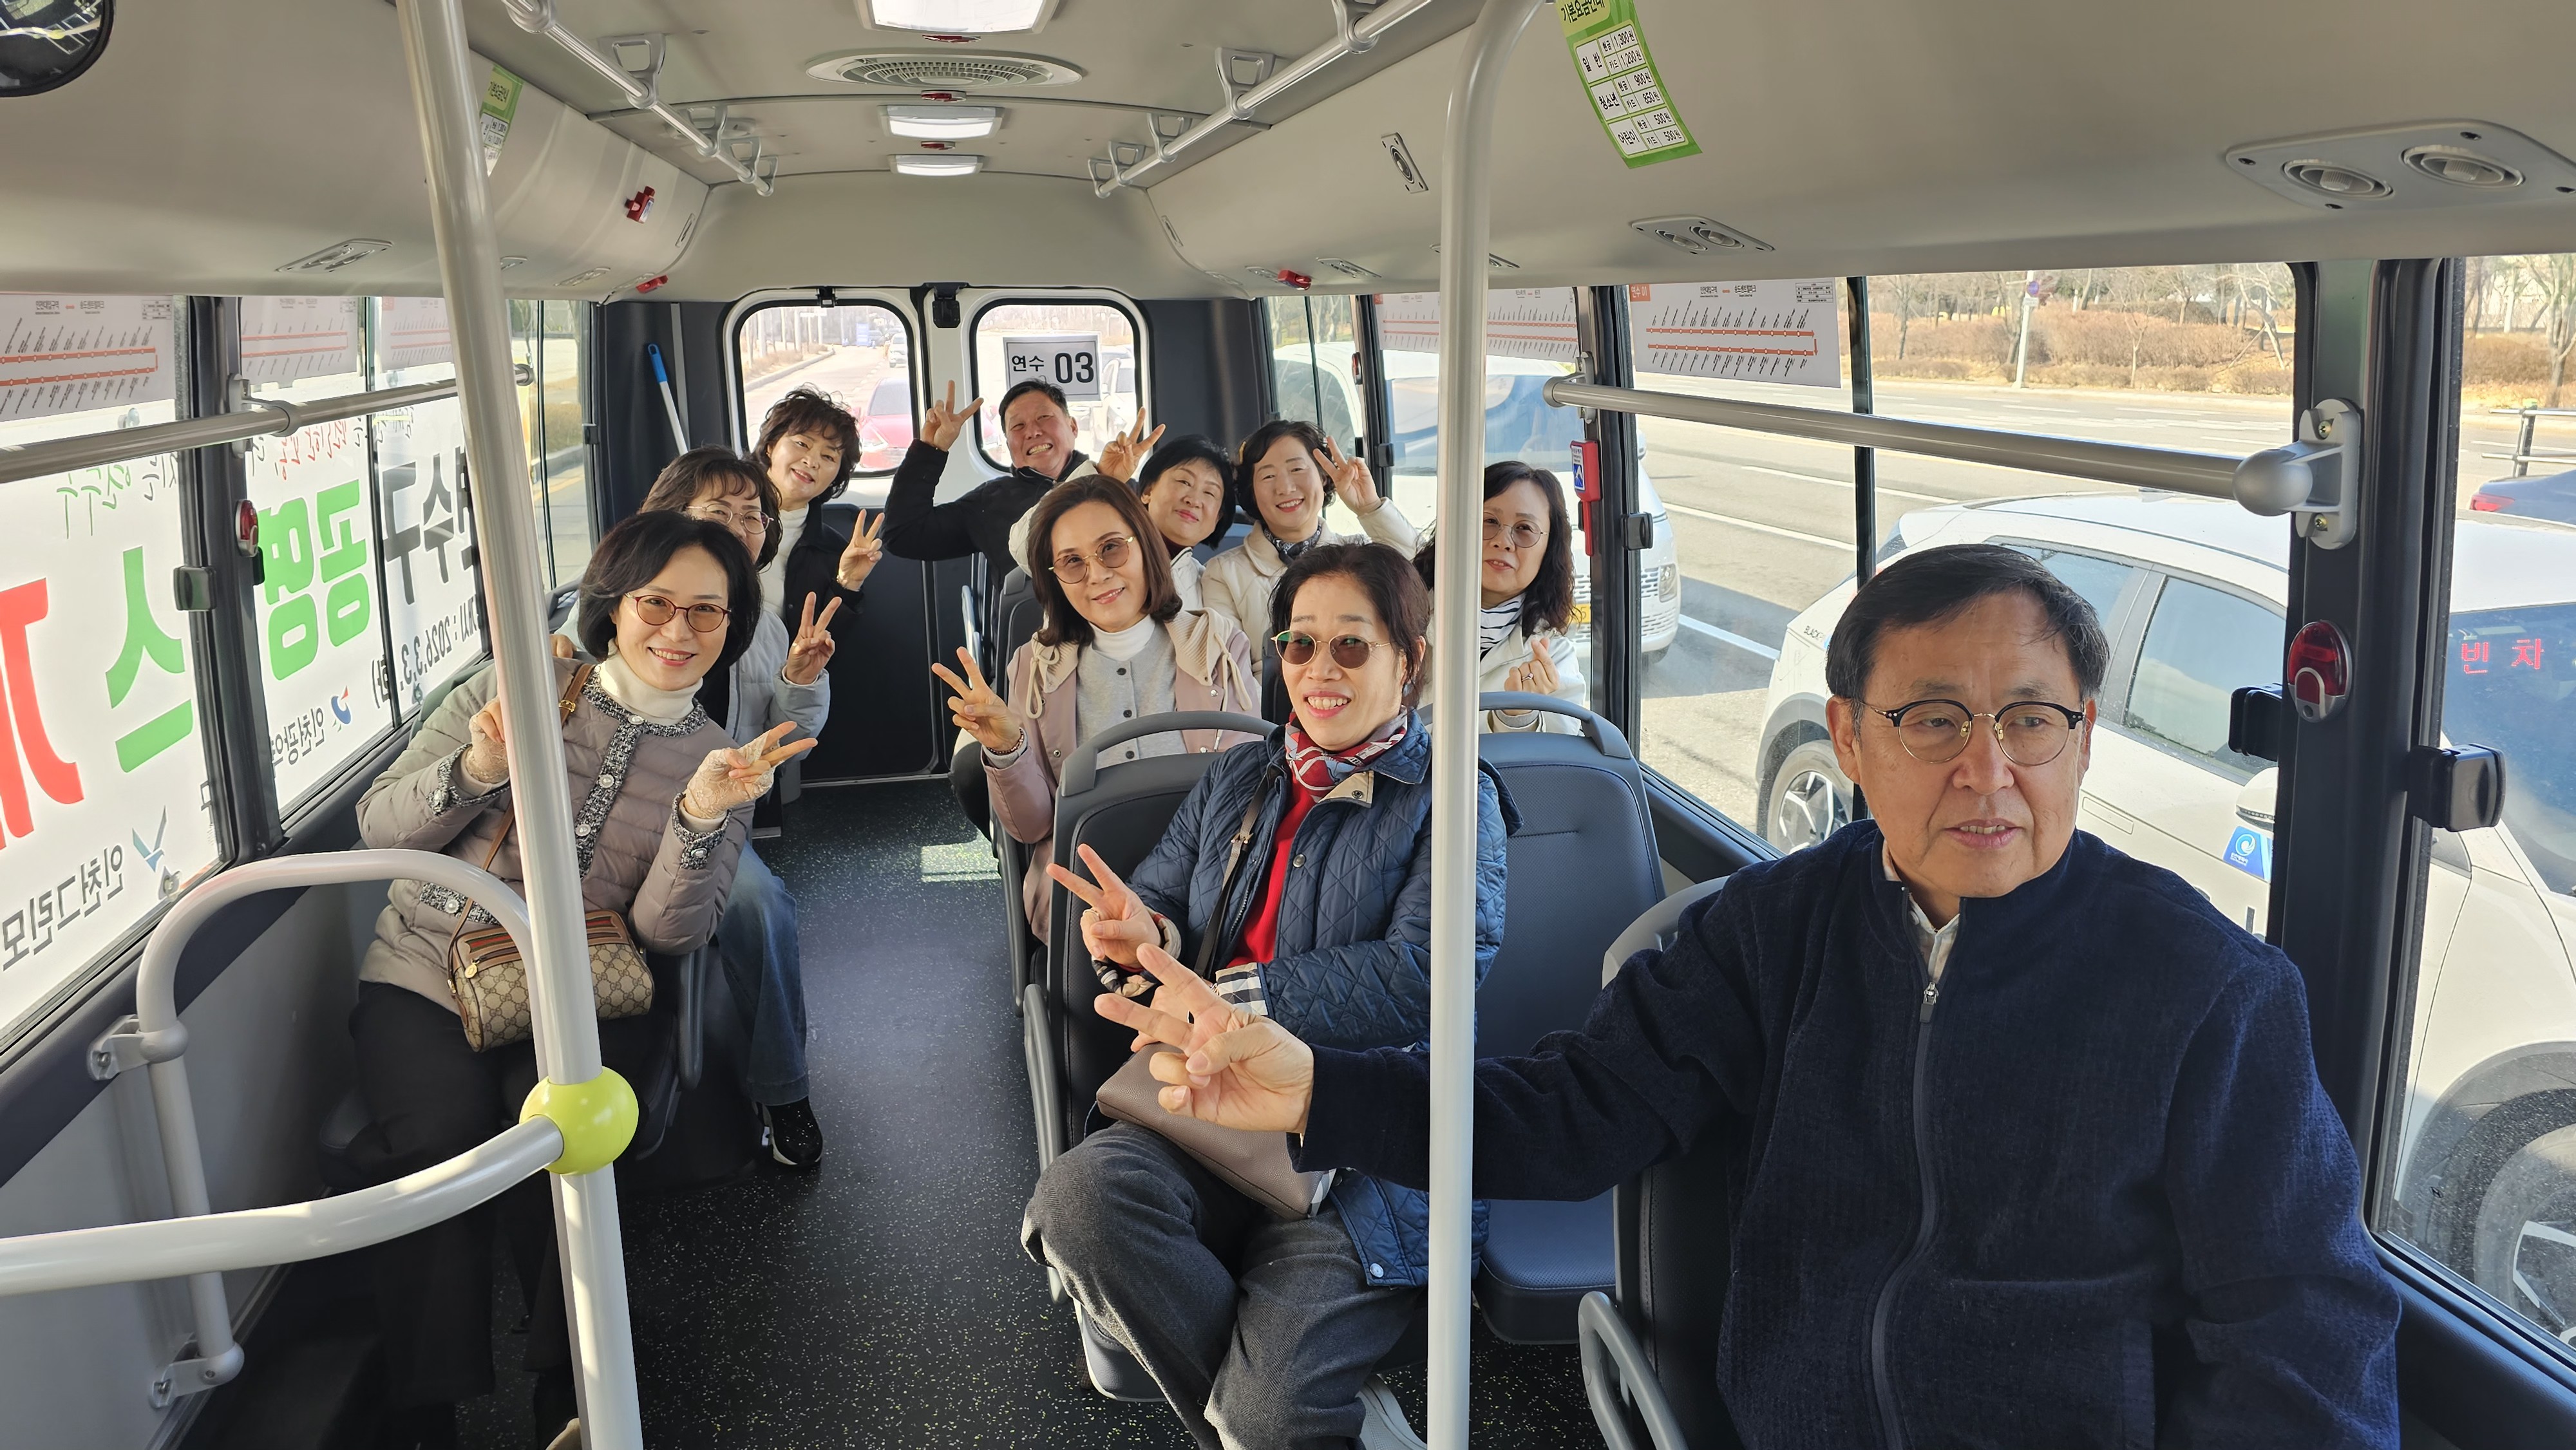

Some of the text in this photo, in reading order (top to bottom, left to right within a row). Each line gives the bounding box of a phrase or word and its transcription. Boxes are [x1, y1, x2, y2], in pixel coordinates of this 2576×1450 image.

[1602, 30, 1635, 52] 현금 1,300원
[1609, 49, 1643, 70] 카드 1,200원
[1618, 71, 1652, 92] 현금 900원
[1598, 92, 1620, 110] 청소년
[1626, 90, 1661, 109] 카드 850원
[1636, 112, 1672, 129] 현금 500원
[1618, 129, 1640, 146] 어린이
[1646, 129, 1682, 146] 카드 500원
[1642, 286, 1647, 296] 01
[1012, 352, 1094, 384] 연수 03
